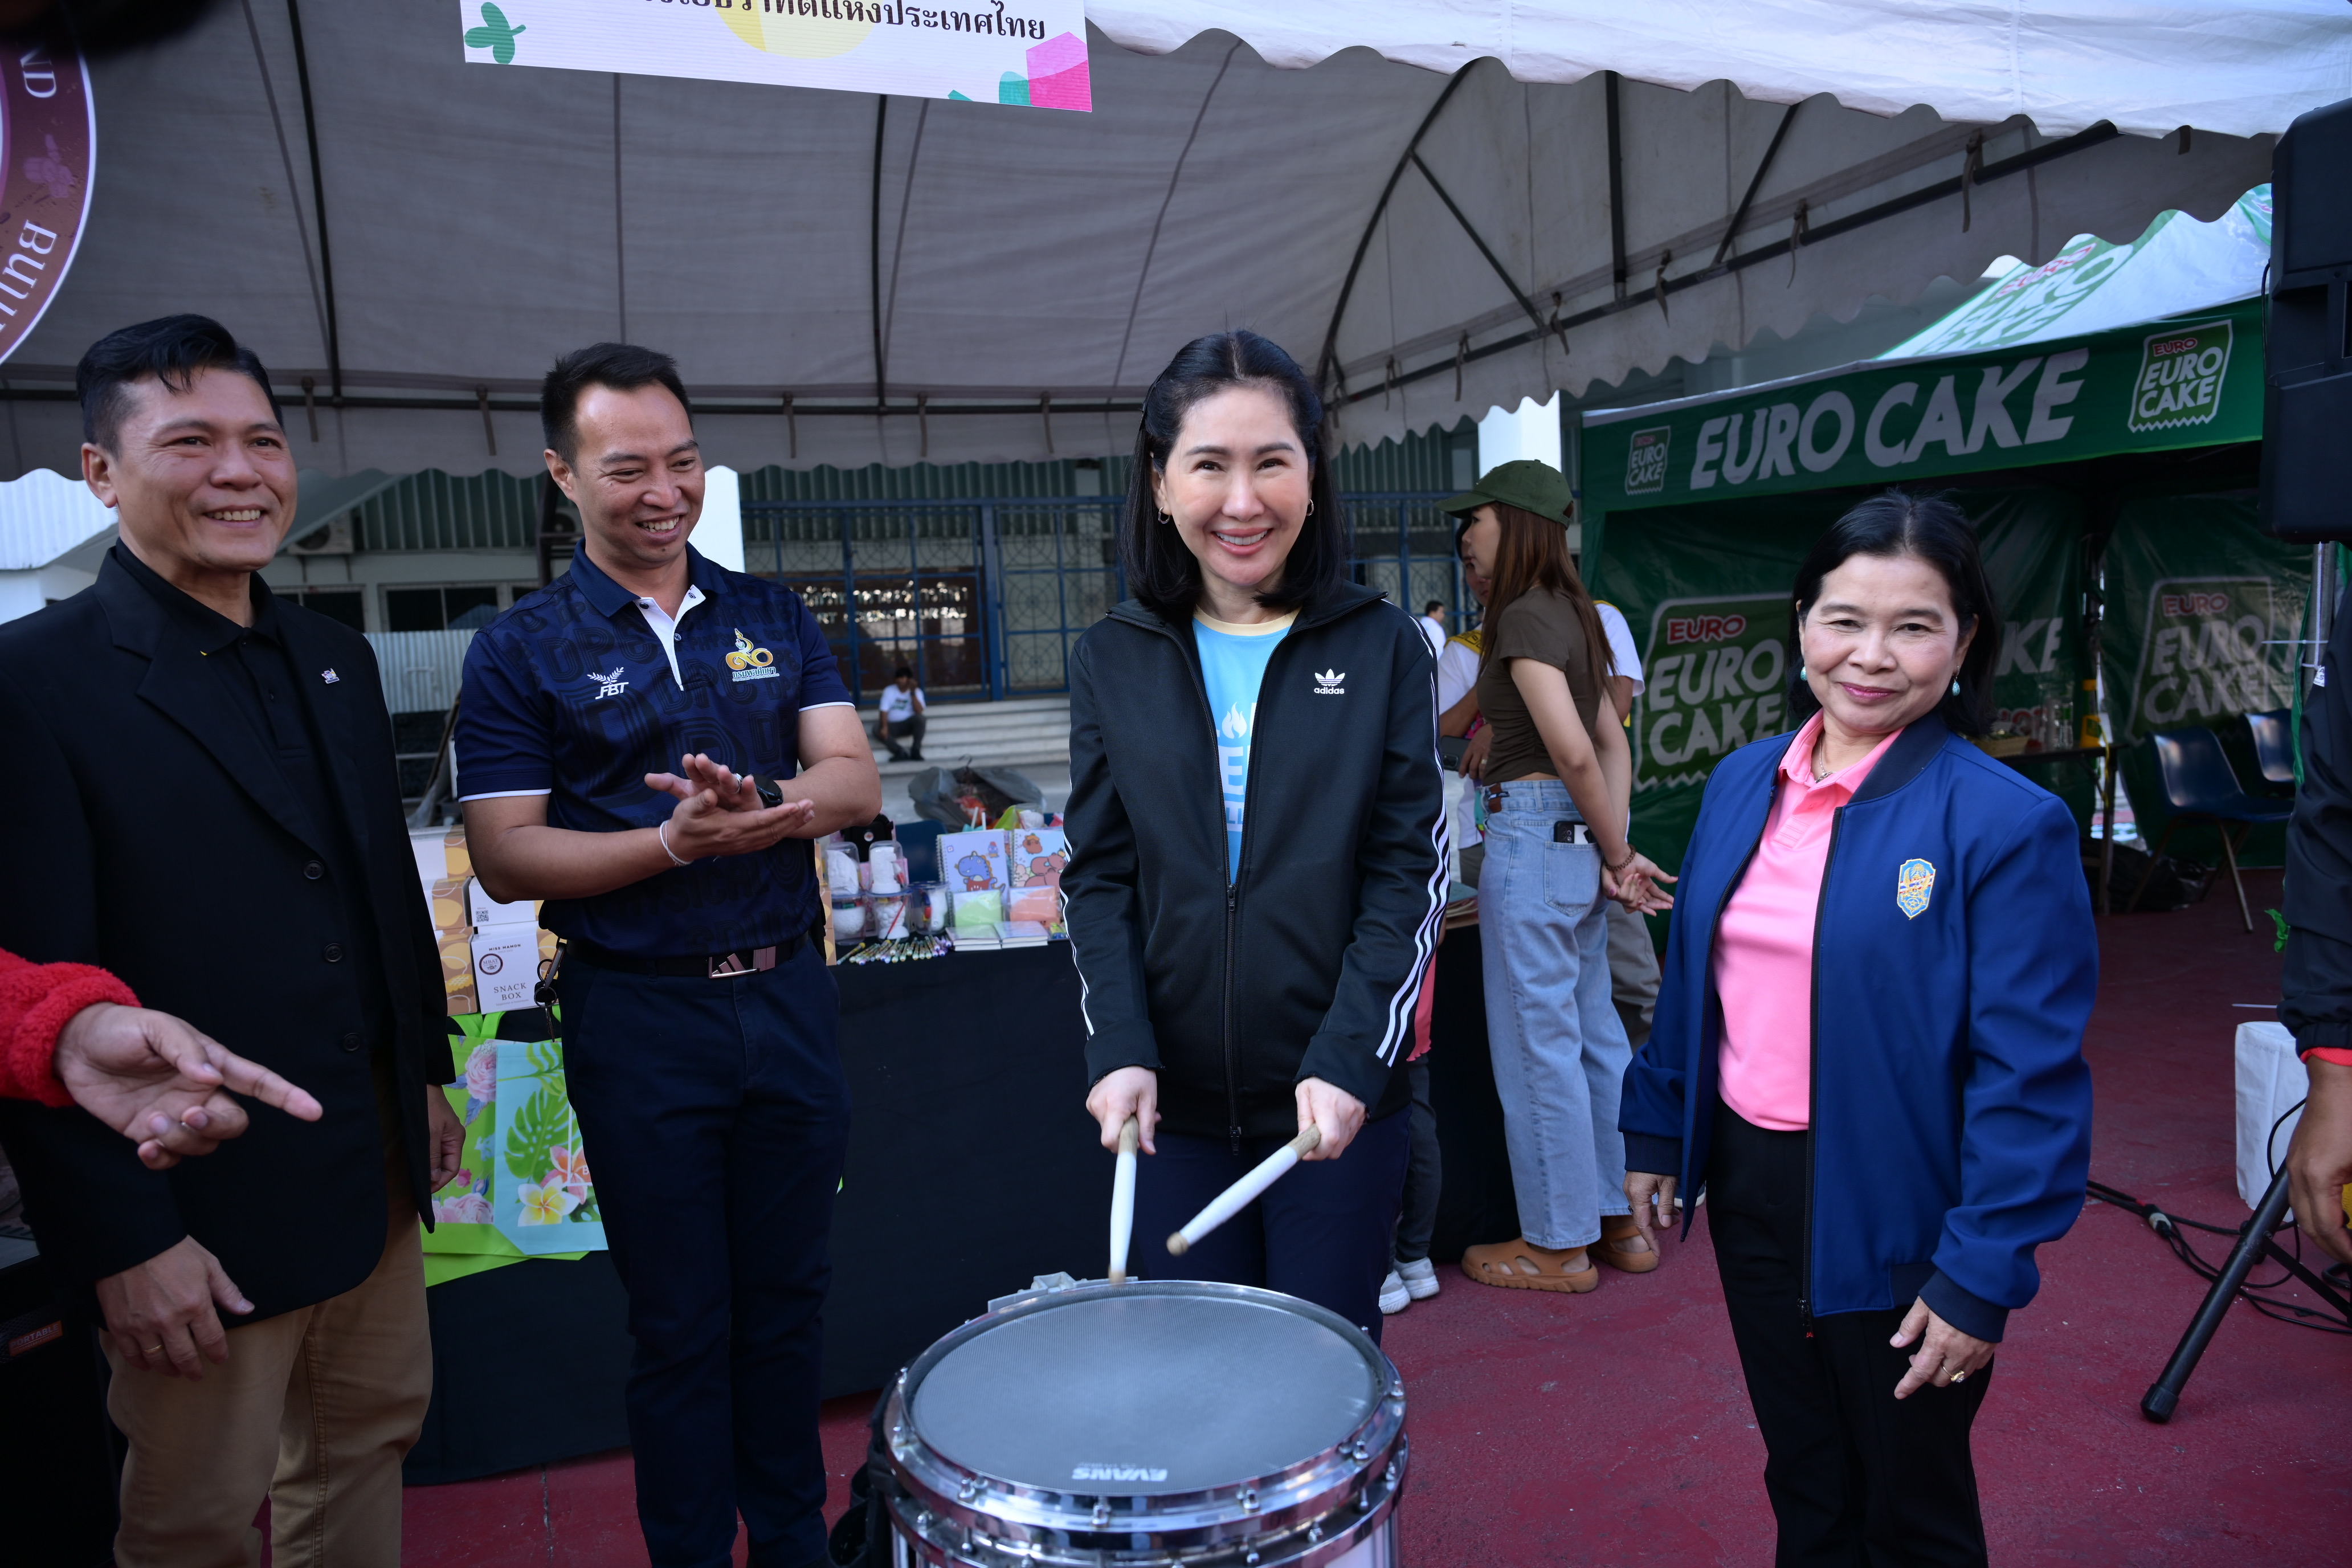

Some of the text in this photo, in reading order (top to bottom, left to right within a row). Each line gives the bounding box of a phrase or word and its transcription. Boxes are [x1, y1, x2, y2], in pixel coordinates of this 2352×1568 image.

[2153, 337, 2198, 357] EURO
[2141, 346, 2223, 391] EURO
[2138, 375, 2217, 418] CAKE
[1689, 347, 2090, 491] EURO CAKE
[1631, 443, 1665, 468] EURO
[1629, 462, 1664, 487] CAKE
[2162, 593, 2229, 617] EURO
[1667, 614, 1746, 645] EURO
[2150, 615, 2265, 677] EURO
[732, 667, 776, 679] กรมพลศึกษา
[1649, 638, 1785, 712] EURO
[595, 682, 628, 700] FBT
[2143, 663, 2260, 724] CAKE
[1649, 693, 1782, 766] CAKE
[493, 982, 527, 994] SNACK
[501, 992, 522, 1001] BOX
[11, 1323, 59, 1347] PORTABLE
[1071, 1467, 1168, 1482] EVANS
